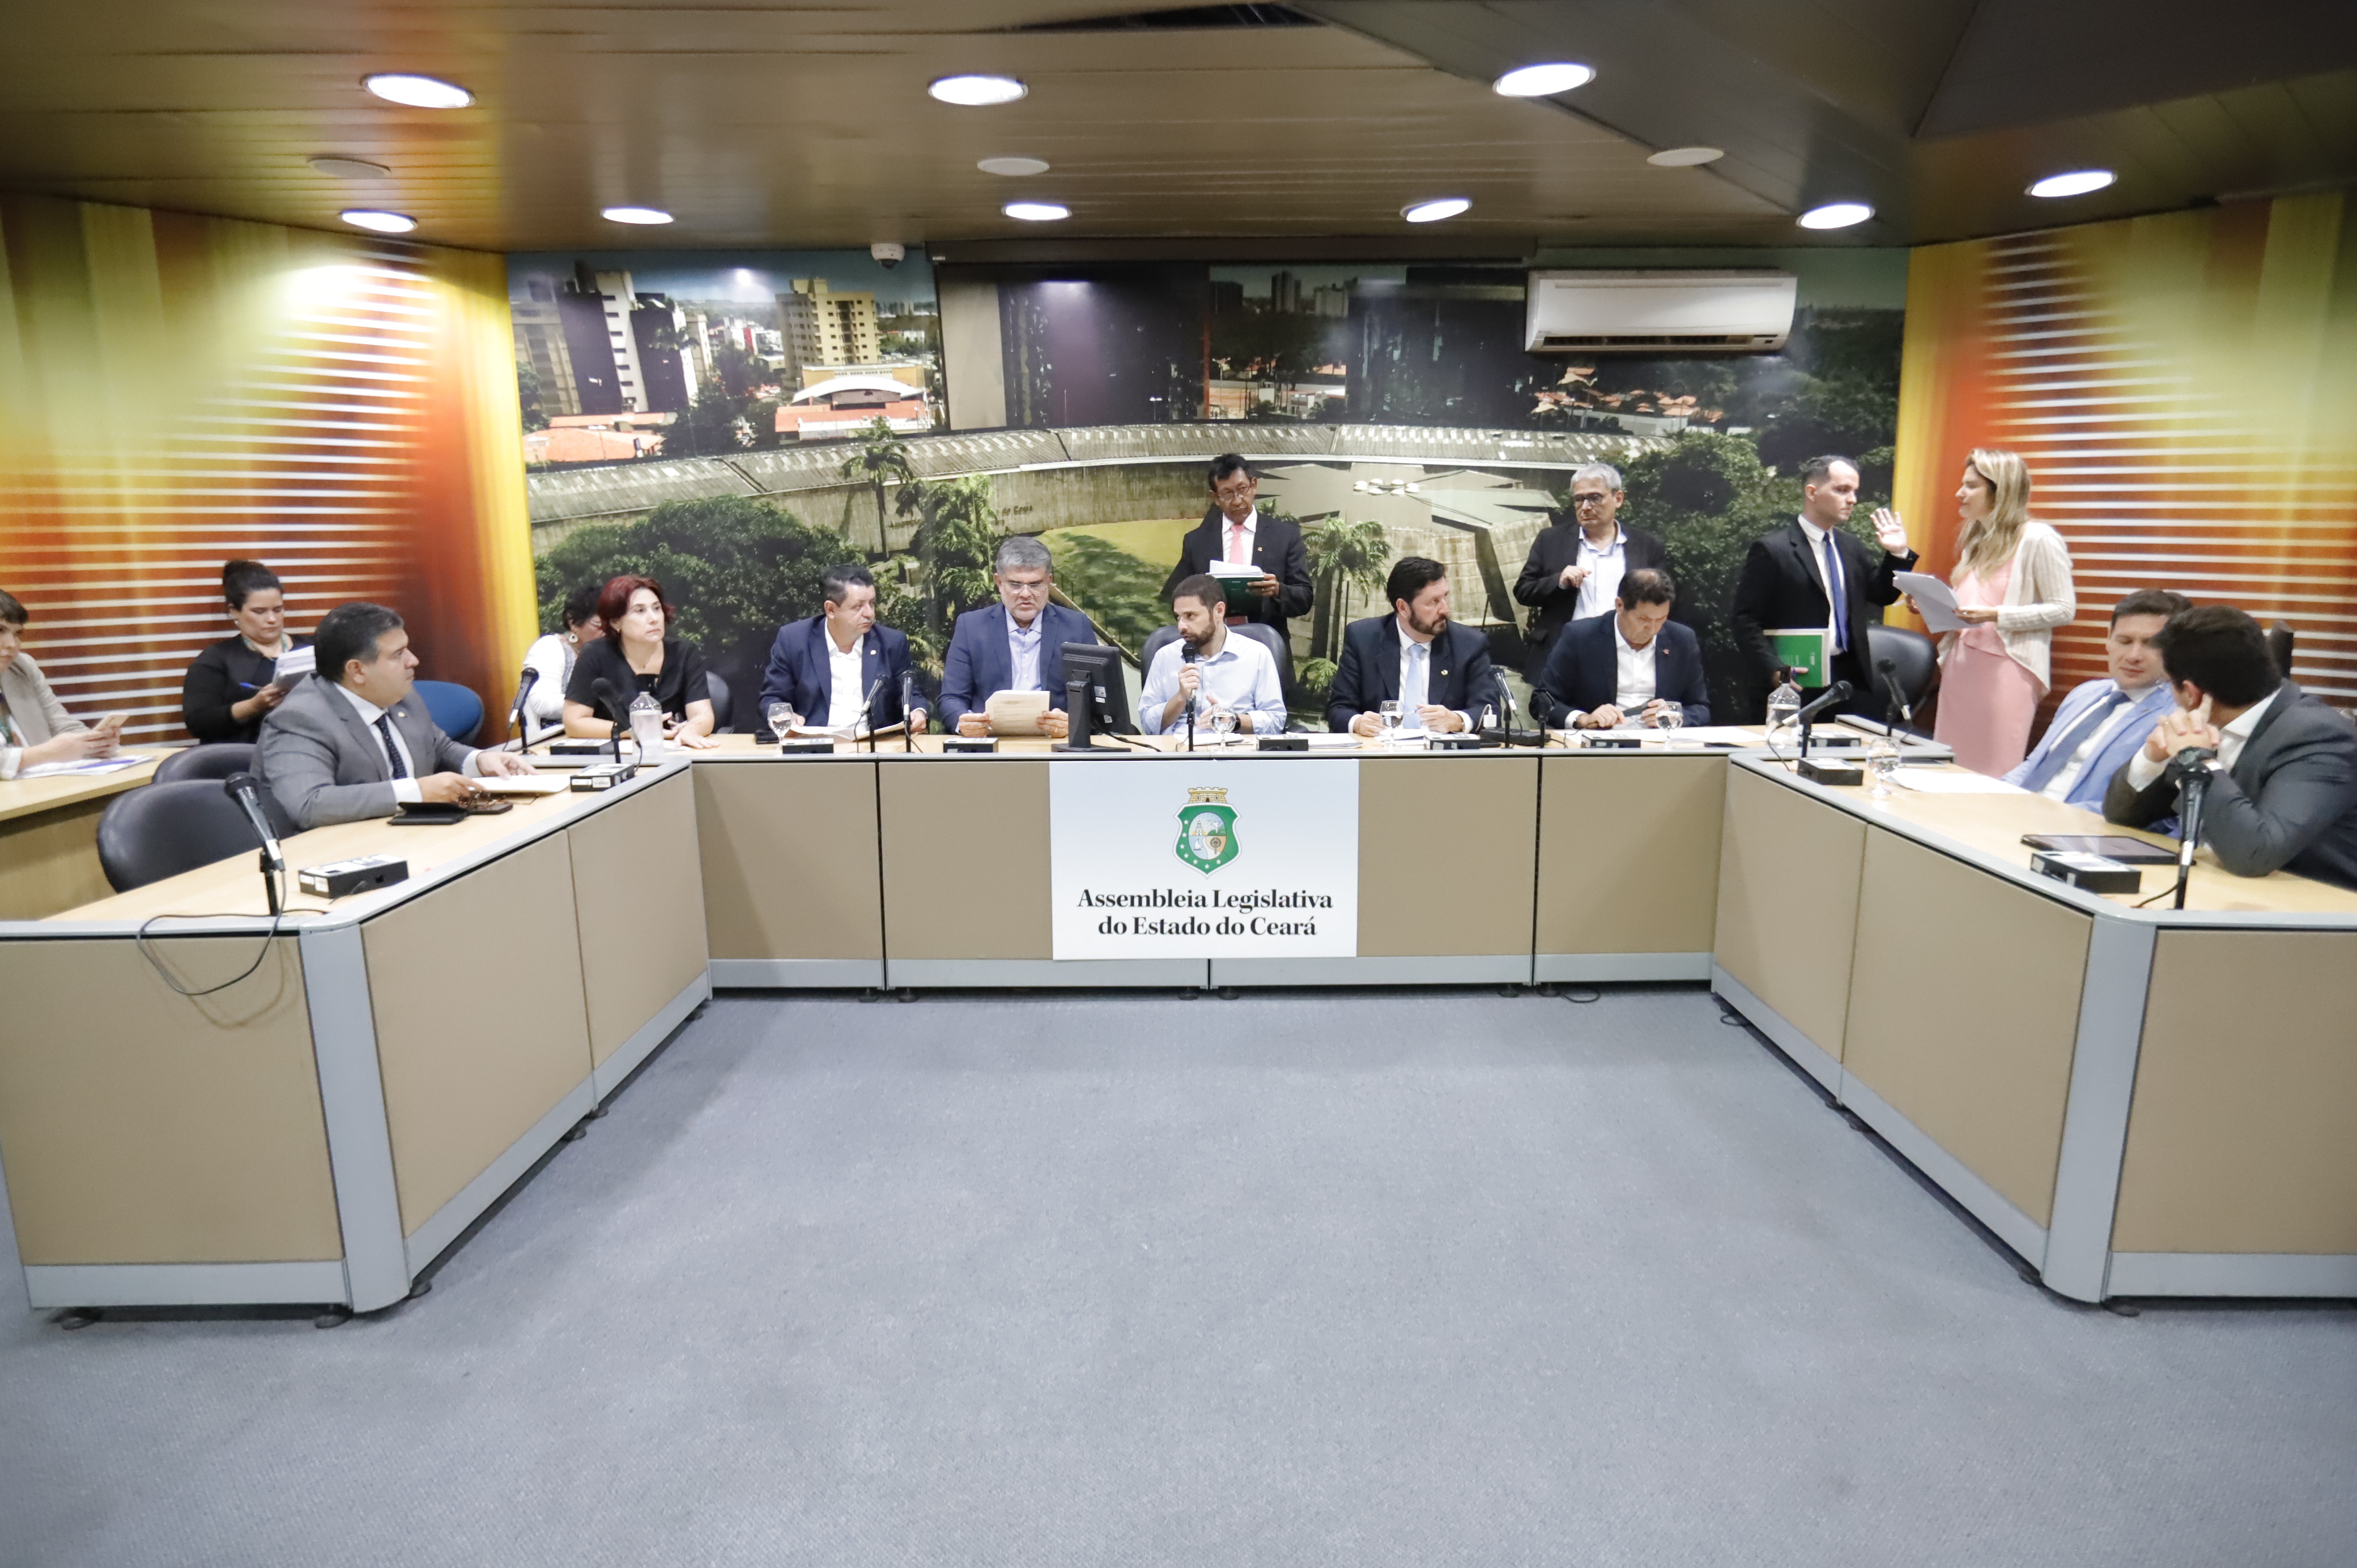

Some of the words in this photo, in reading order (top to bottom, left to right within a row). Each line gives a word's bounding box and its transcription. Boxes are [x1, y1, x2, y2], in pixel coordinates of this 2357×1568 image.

[1078, 889, 1207, 907] Assembleia
[1212, 889, 1333, 914] Legislativa
[1098, 916, 1127, 935] do
[1133, 916, 1210, 935] Estado
[1215, 916, 1245, 935] do
[1250, 916, 1316, 935] Ceará
